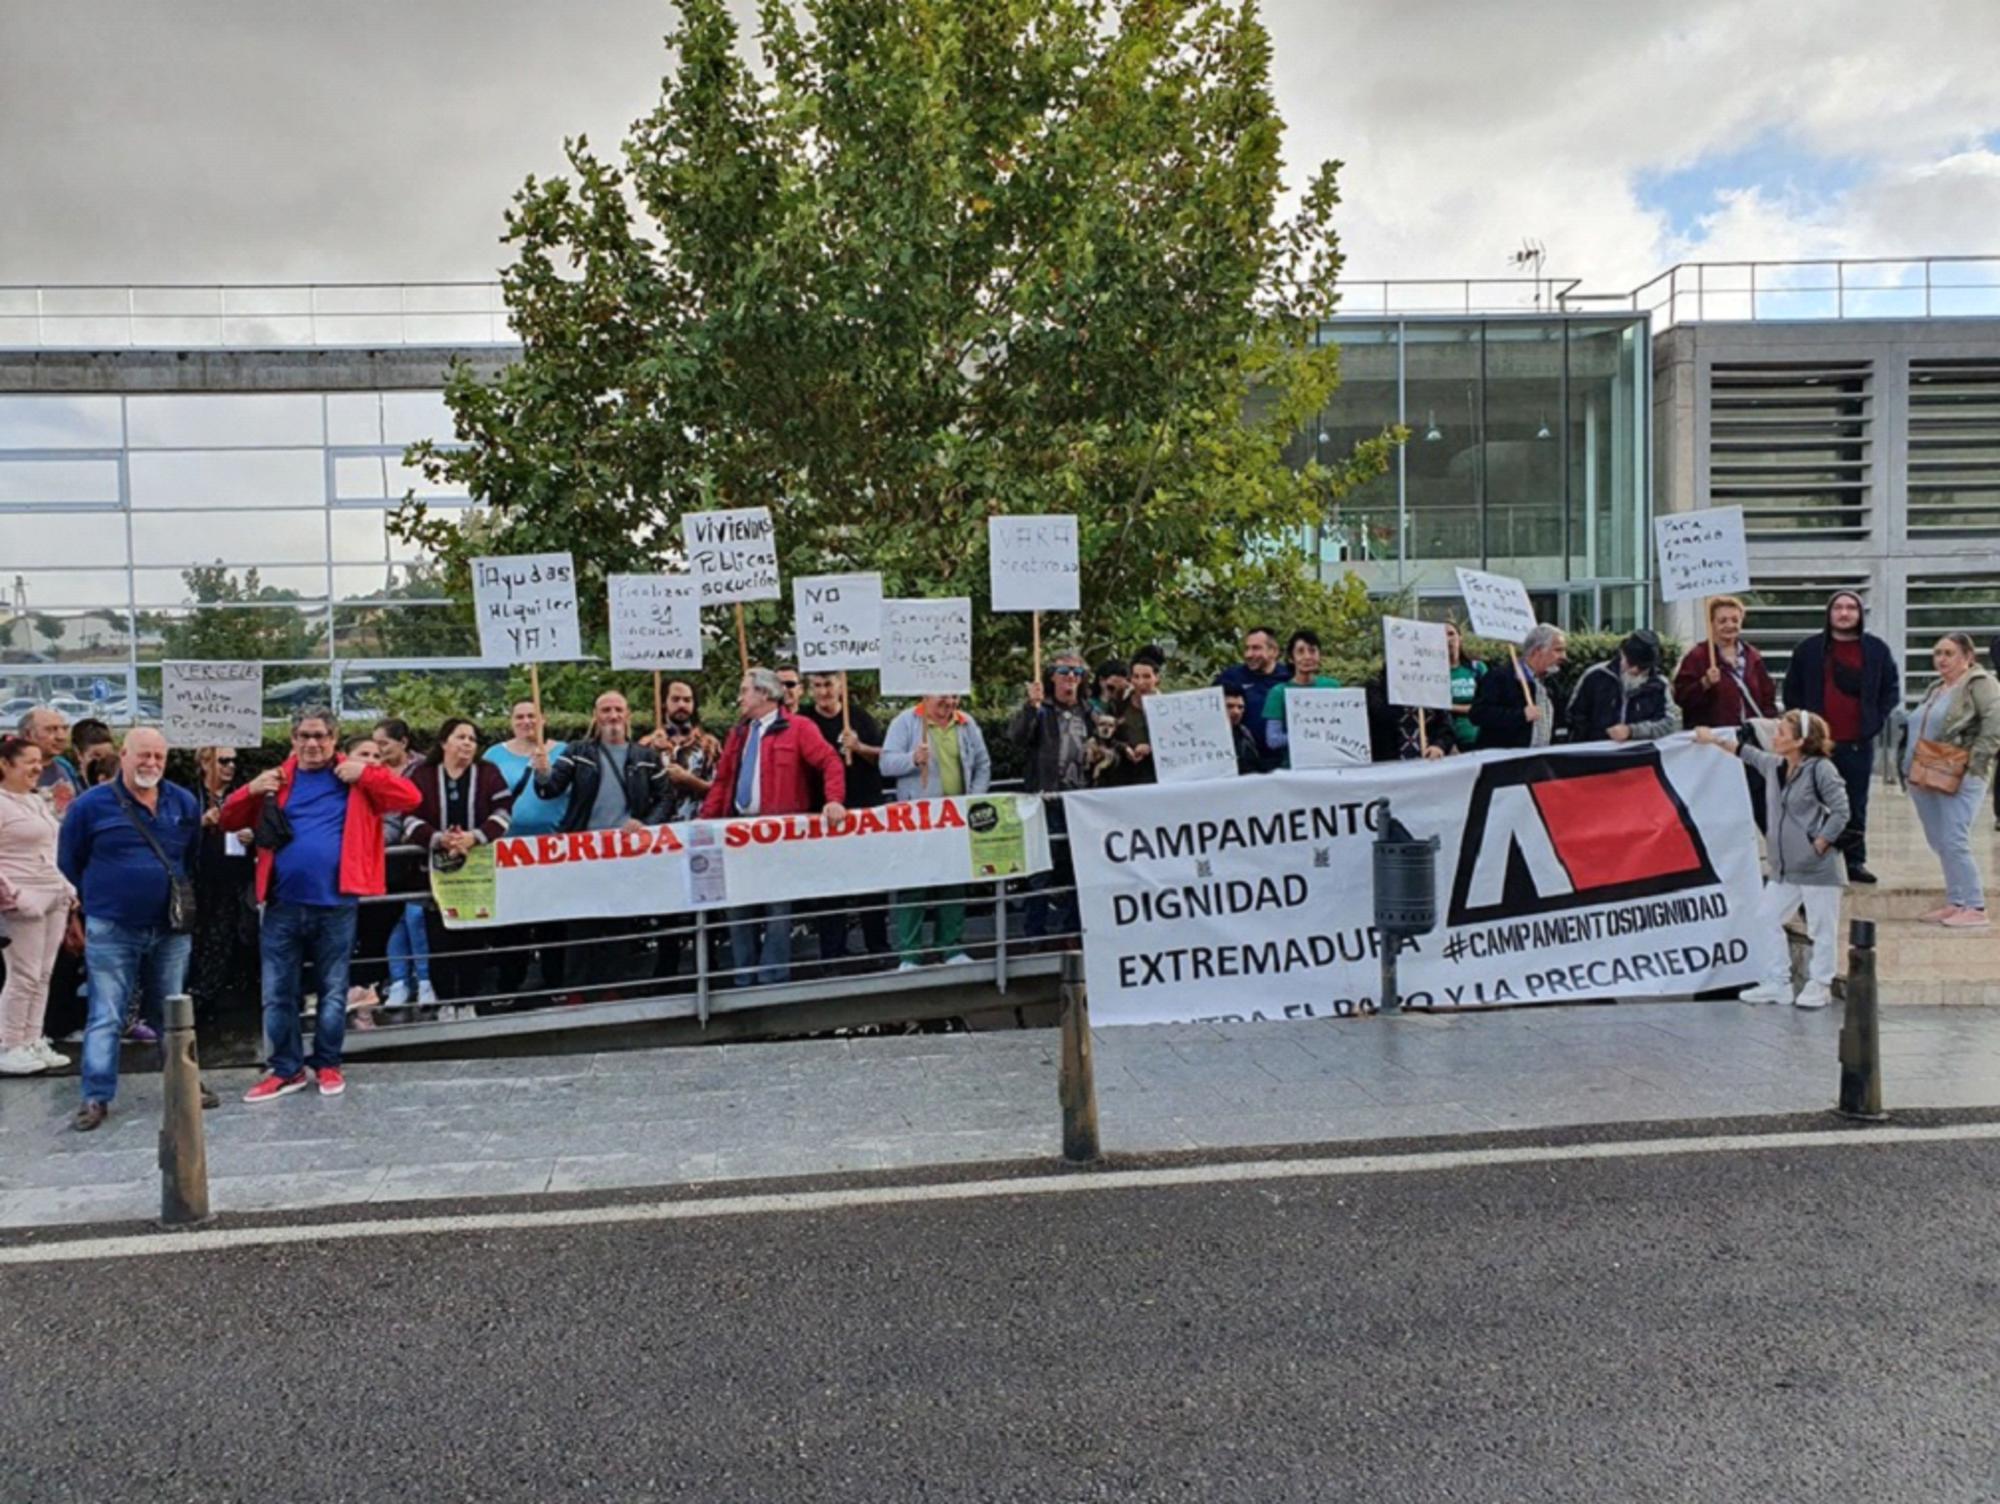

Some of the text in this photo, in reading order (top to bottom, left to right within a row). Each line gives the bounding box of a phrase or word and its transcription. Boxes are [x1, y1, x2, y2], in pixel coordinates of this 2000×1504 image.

[805, 587, 840, 606] NO
[496, 823, 683, 868] MERIDA
[725, 799, 965, 848] SOLIDARIA
[1112, 873, 1309, 925] DIGNIDAD
[1443, 892, 1728, 964] #CAMPAMENTOSDIGNIDAD
[1524, 937, 1749, 998] PRECARIEDAD
